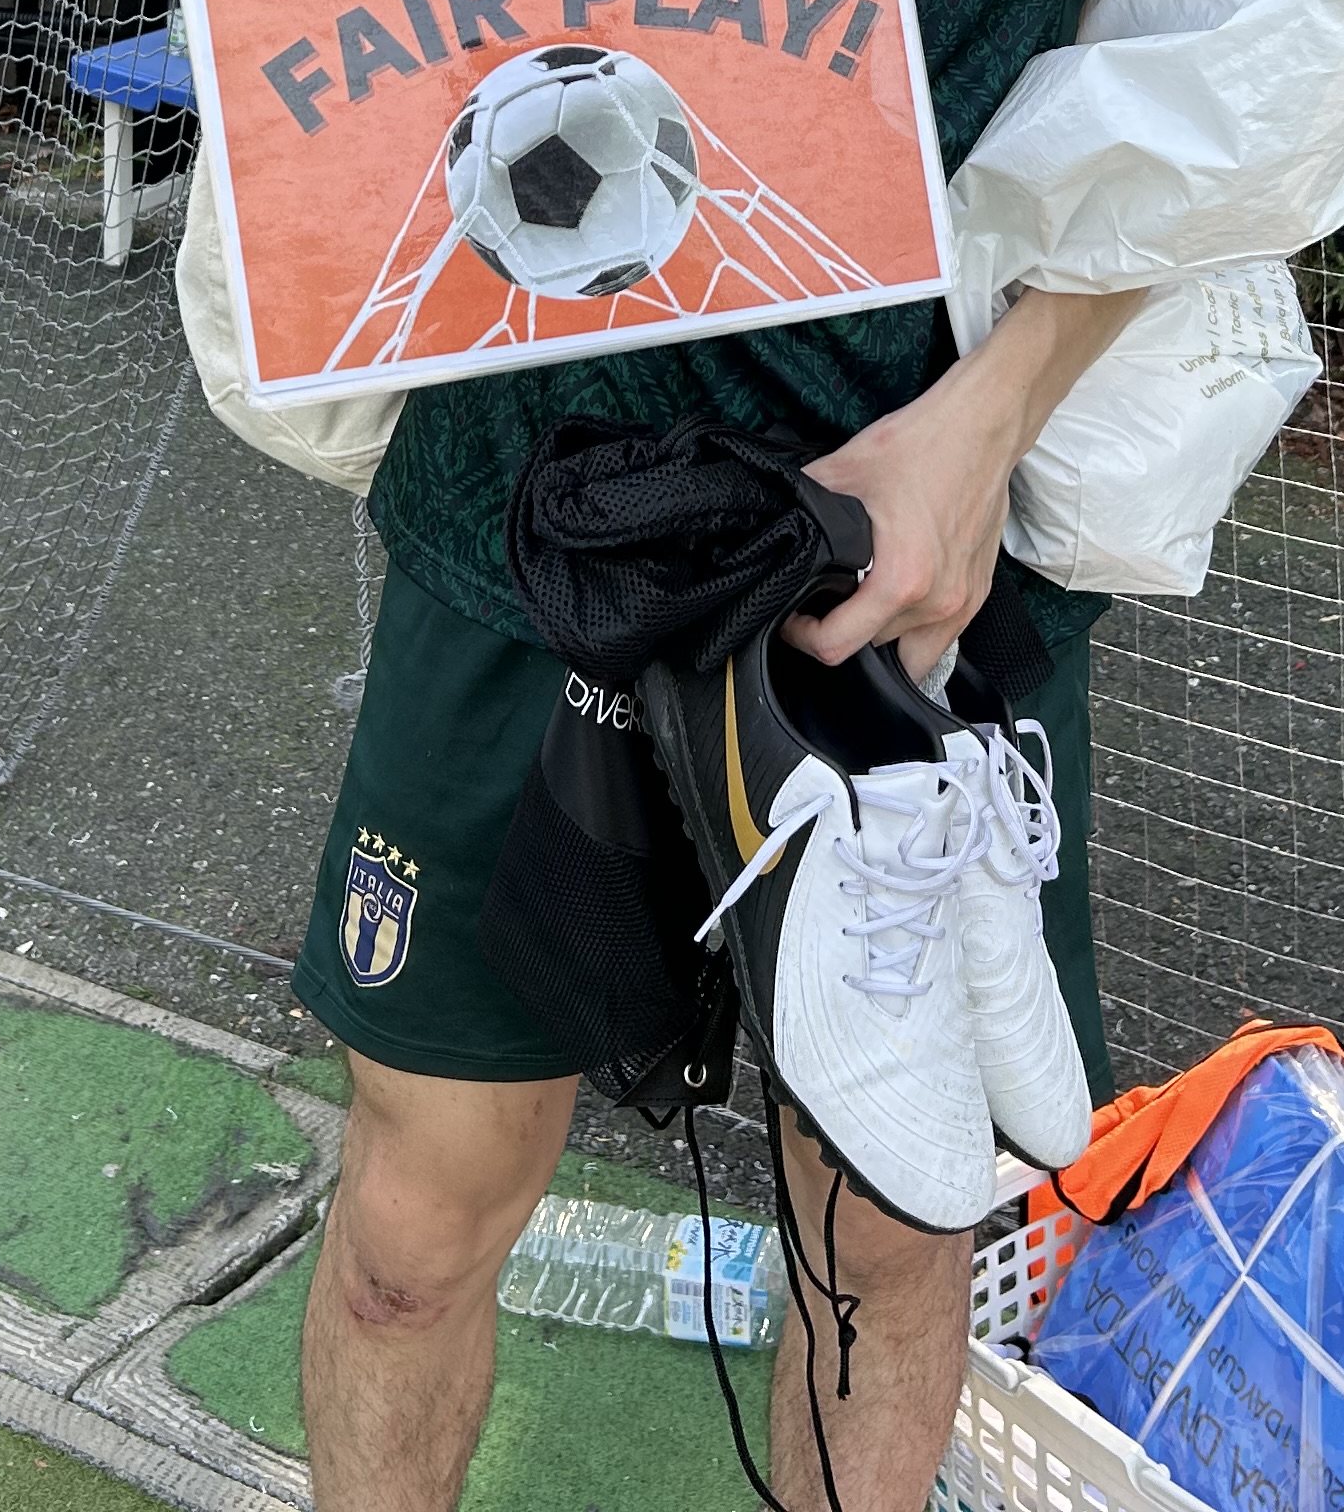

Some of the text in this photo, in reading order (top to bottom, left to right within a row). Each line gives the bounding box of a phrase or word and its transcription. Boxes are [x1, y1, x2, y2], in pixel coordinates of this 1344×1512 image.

[1200, 369, 1247, 399] Uniform
[352, 866, 404, 914] ITALIA
[1117, 1222, 1207, 1340] HAMPIONS
